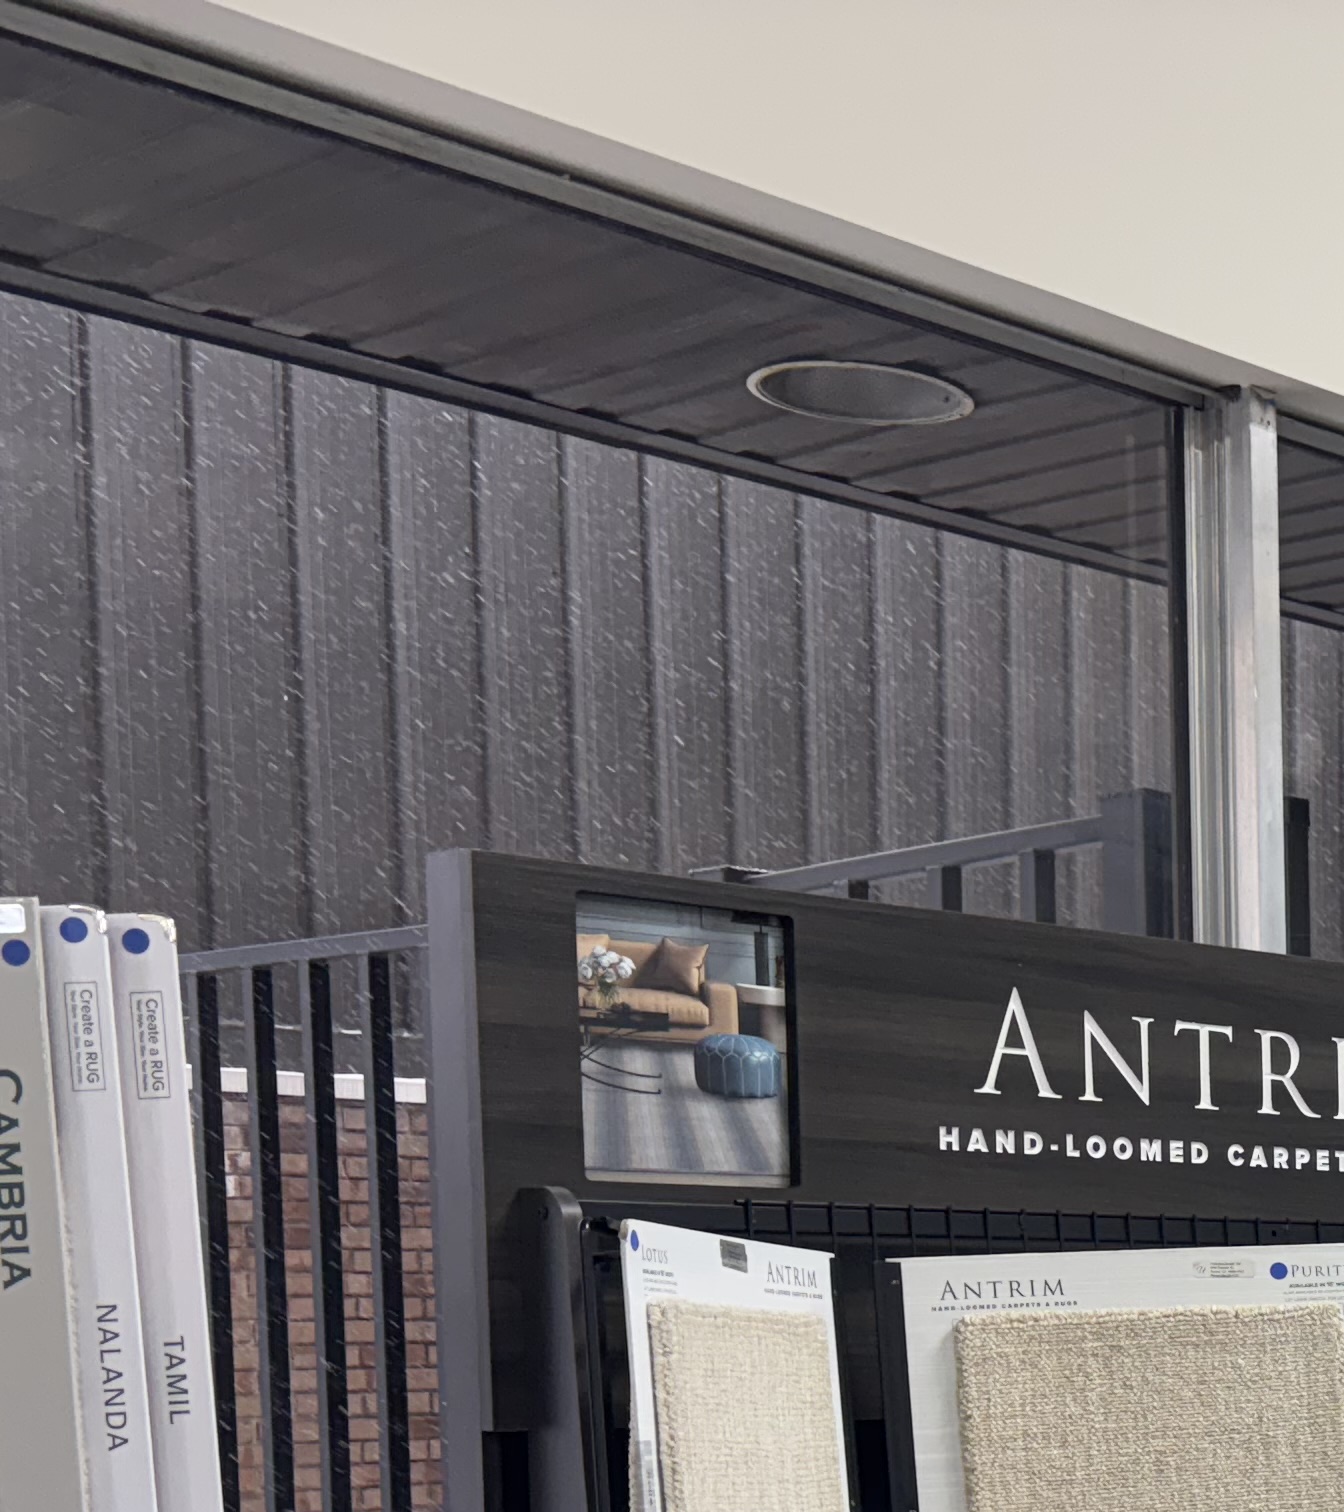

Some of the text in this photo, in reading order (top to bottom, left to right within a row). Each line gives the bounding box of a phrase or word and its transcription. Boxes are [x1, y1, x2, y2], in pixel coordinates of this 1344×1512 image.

[80, 989, 95, 1035] Create
[86, 1052, 100, 1083] RUG
[938, 1125, 1208, 1165] HAND-LOOMED
[0, 1069, 31, 1290] CAMBRIA
[641, 1244, 669, 1265] LOTUS
[766, 1260, 818, 1289] ANTRIM
[940, 1278, 1065, 1301] ANTRIM
[95, 1304, 129, 1452] NALANDA
[163, 1336, 191, 1425] TAMIL
